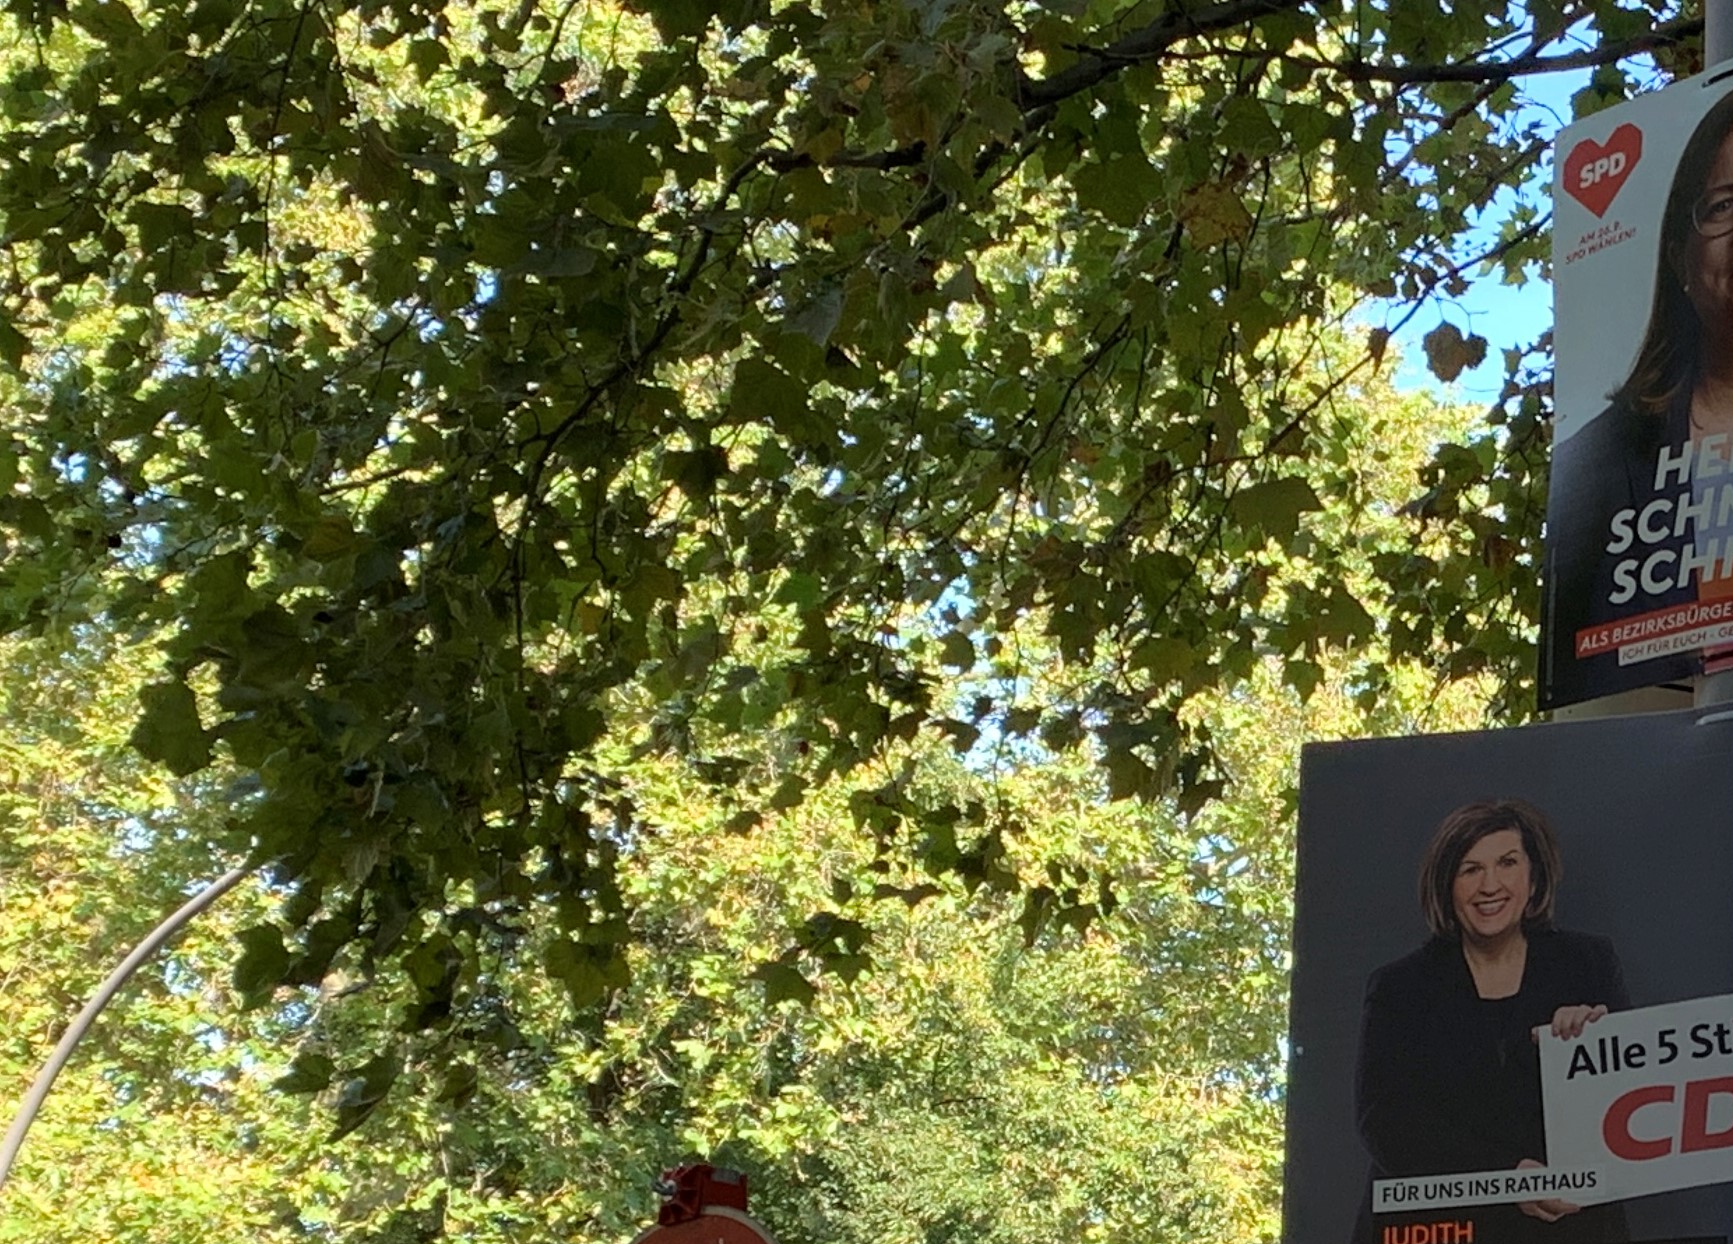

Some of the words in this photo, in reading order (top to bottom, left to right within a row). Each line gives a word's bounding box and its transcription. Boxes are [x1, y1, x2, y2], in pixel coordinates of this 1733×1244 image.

[1579, 152, 1626, 189] SPD
[1578, 232, 1596, 246] AM
[1565, 248, 1587, 265] SPD
[1579, 630, 1609, 652] ALS
[1622, 644, 1645, 661] ICH
[1646, 637, 1670, 655] FÜR
[1671, 631, 1707, 650] EUCH
[1565, 1034, 1647, 1080] Alle
[1656, 1027, 1678, 1065] 5
[1382, 1181, 1420, 1204] FÜR
[1423, 1180, 1465, 1201] UNS
[1468, 1178, 1500, 1197] INS
[1505, 1169, 1598, 1195] RATHAUS
